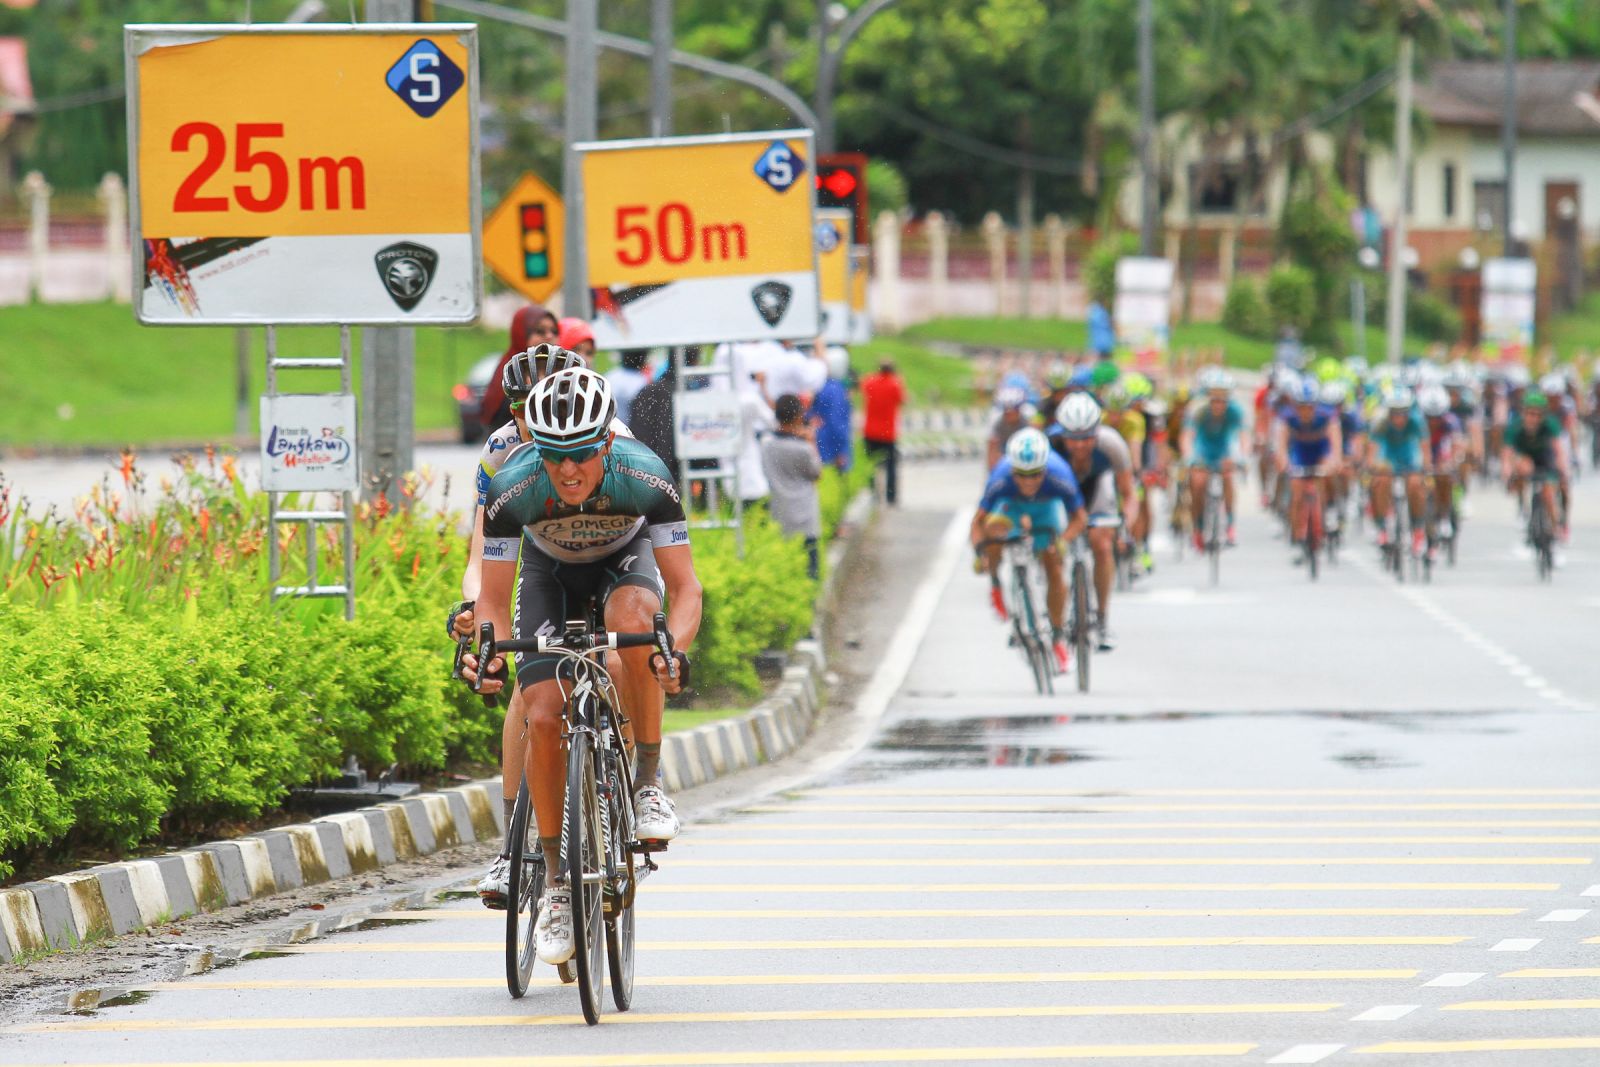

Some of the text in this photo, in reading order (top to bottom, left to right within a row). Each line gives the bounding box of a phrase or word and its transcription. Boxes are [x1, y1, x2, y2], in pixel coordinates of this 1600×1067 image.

[409, 52, 441, 103] S
[170, 121, 366, 213] 25m
[766, 149, 794, 187] S
[377, 249, 434, 261] PROTON
[614, 202, 748, 269] 50m
[267, 424, 343, 457] Langkawi
[571, 518, 634, 530] OMEGA
[596, 780, 612, 854] SPECIALIZ
